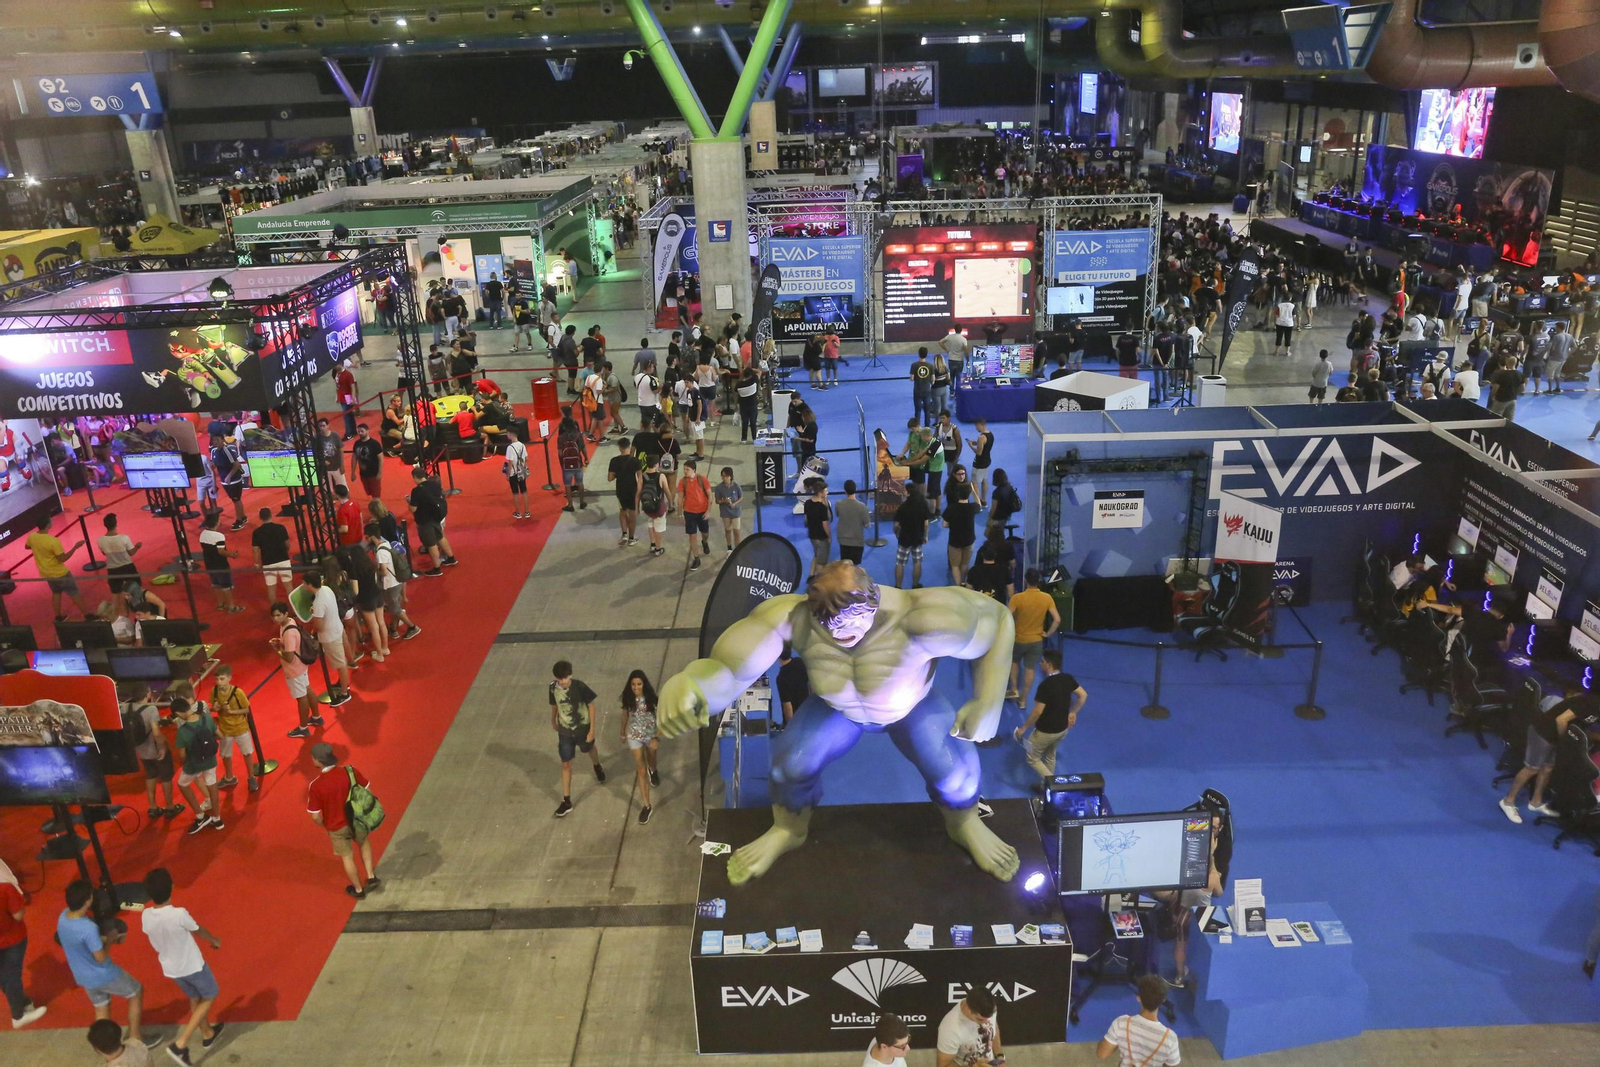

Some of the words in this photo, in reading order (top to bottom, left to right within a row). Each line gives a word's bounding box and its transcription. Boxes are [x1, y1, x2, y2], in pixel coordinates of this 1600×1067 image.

[1332, 37, 1343, 65] 1
[55, 78, 69, 93] 2
[130, 82, 151, 109] 1
[1427, 182, 1458, 195] GAMEPOLIS
[293, 218, 331, 228] Emprende
[804, 222, 840, 230] STORE
[947, 230, 972, 239] TUTORIAL
[772, 246, 819, 261] EVAD
[1056, 240, 1103, 256] EVAD
[780, 268, 822, 279] MÁSTERS
[826, 268, 839, 277] EN
[780, 281, 853, 292] VIDEOJUEGOS
[36, 370, 94, 389] JUEGOS
[17, 391, 123, 413] COMPETITIVOS
[765, 454, 776, 489] EVAD
[1208, 435, 1422, 500] EVAD
[1552, 479, 1580, 494] UPERIOR
[1099, 502, 1138, 511] NAUKOGRAD
[1287, 506, 1297, 514] DE
[1299, 504, 1353, 514] VIDEOJUEGOS
[1362, 503, 1383, 511] ARTE
[1385, 502, 1416, 510] DIGITAL
[1243, 521, 1274, 544] KAIJU
[1533, 534, 1564, 559] VIDEOJUEGOS
[1542, 525, 1555, 538] PARA
[1555, 531, 1587, 557] VIDEOJUEGOS
[736, 565, 793, 594] VIDEOJUEGO
[721, 985, 810, 1007] EVAD
